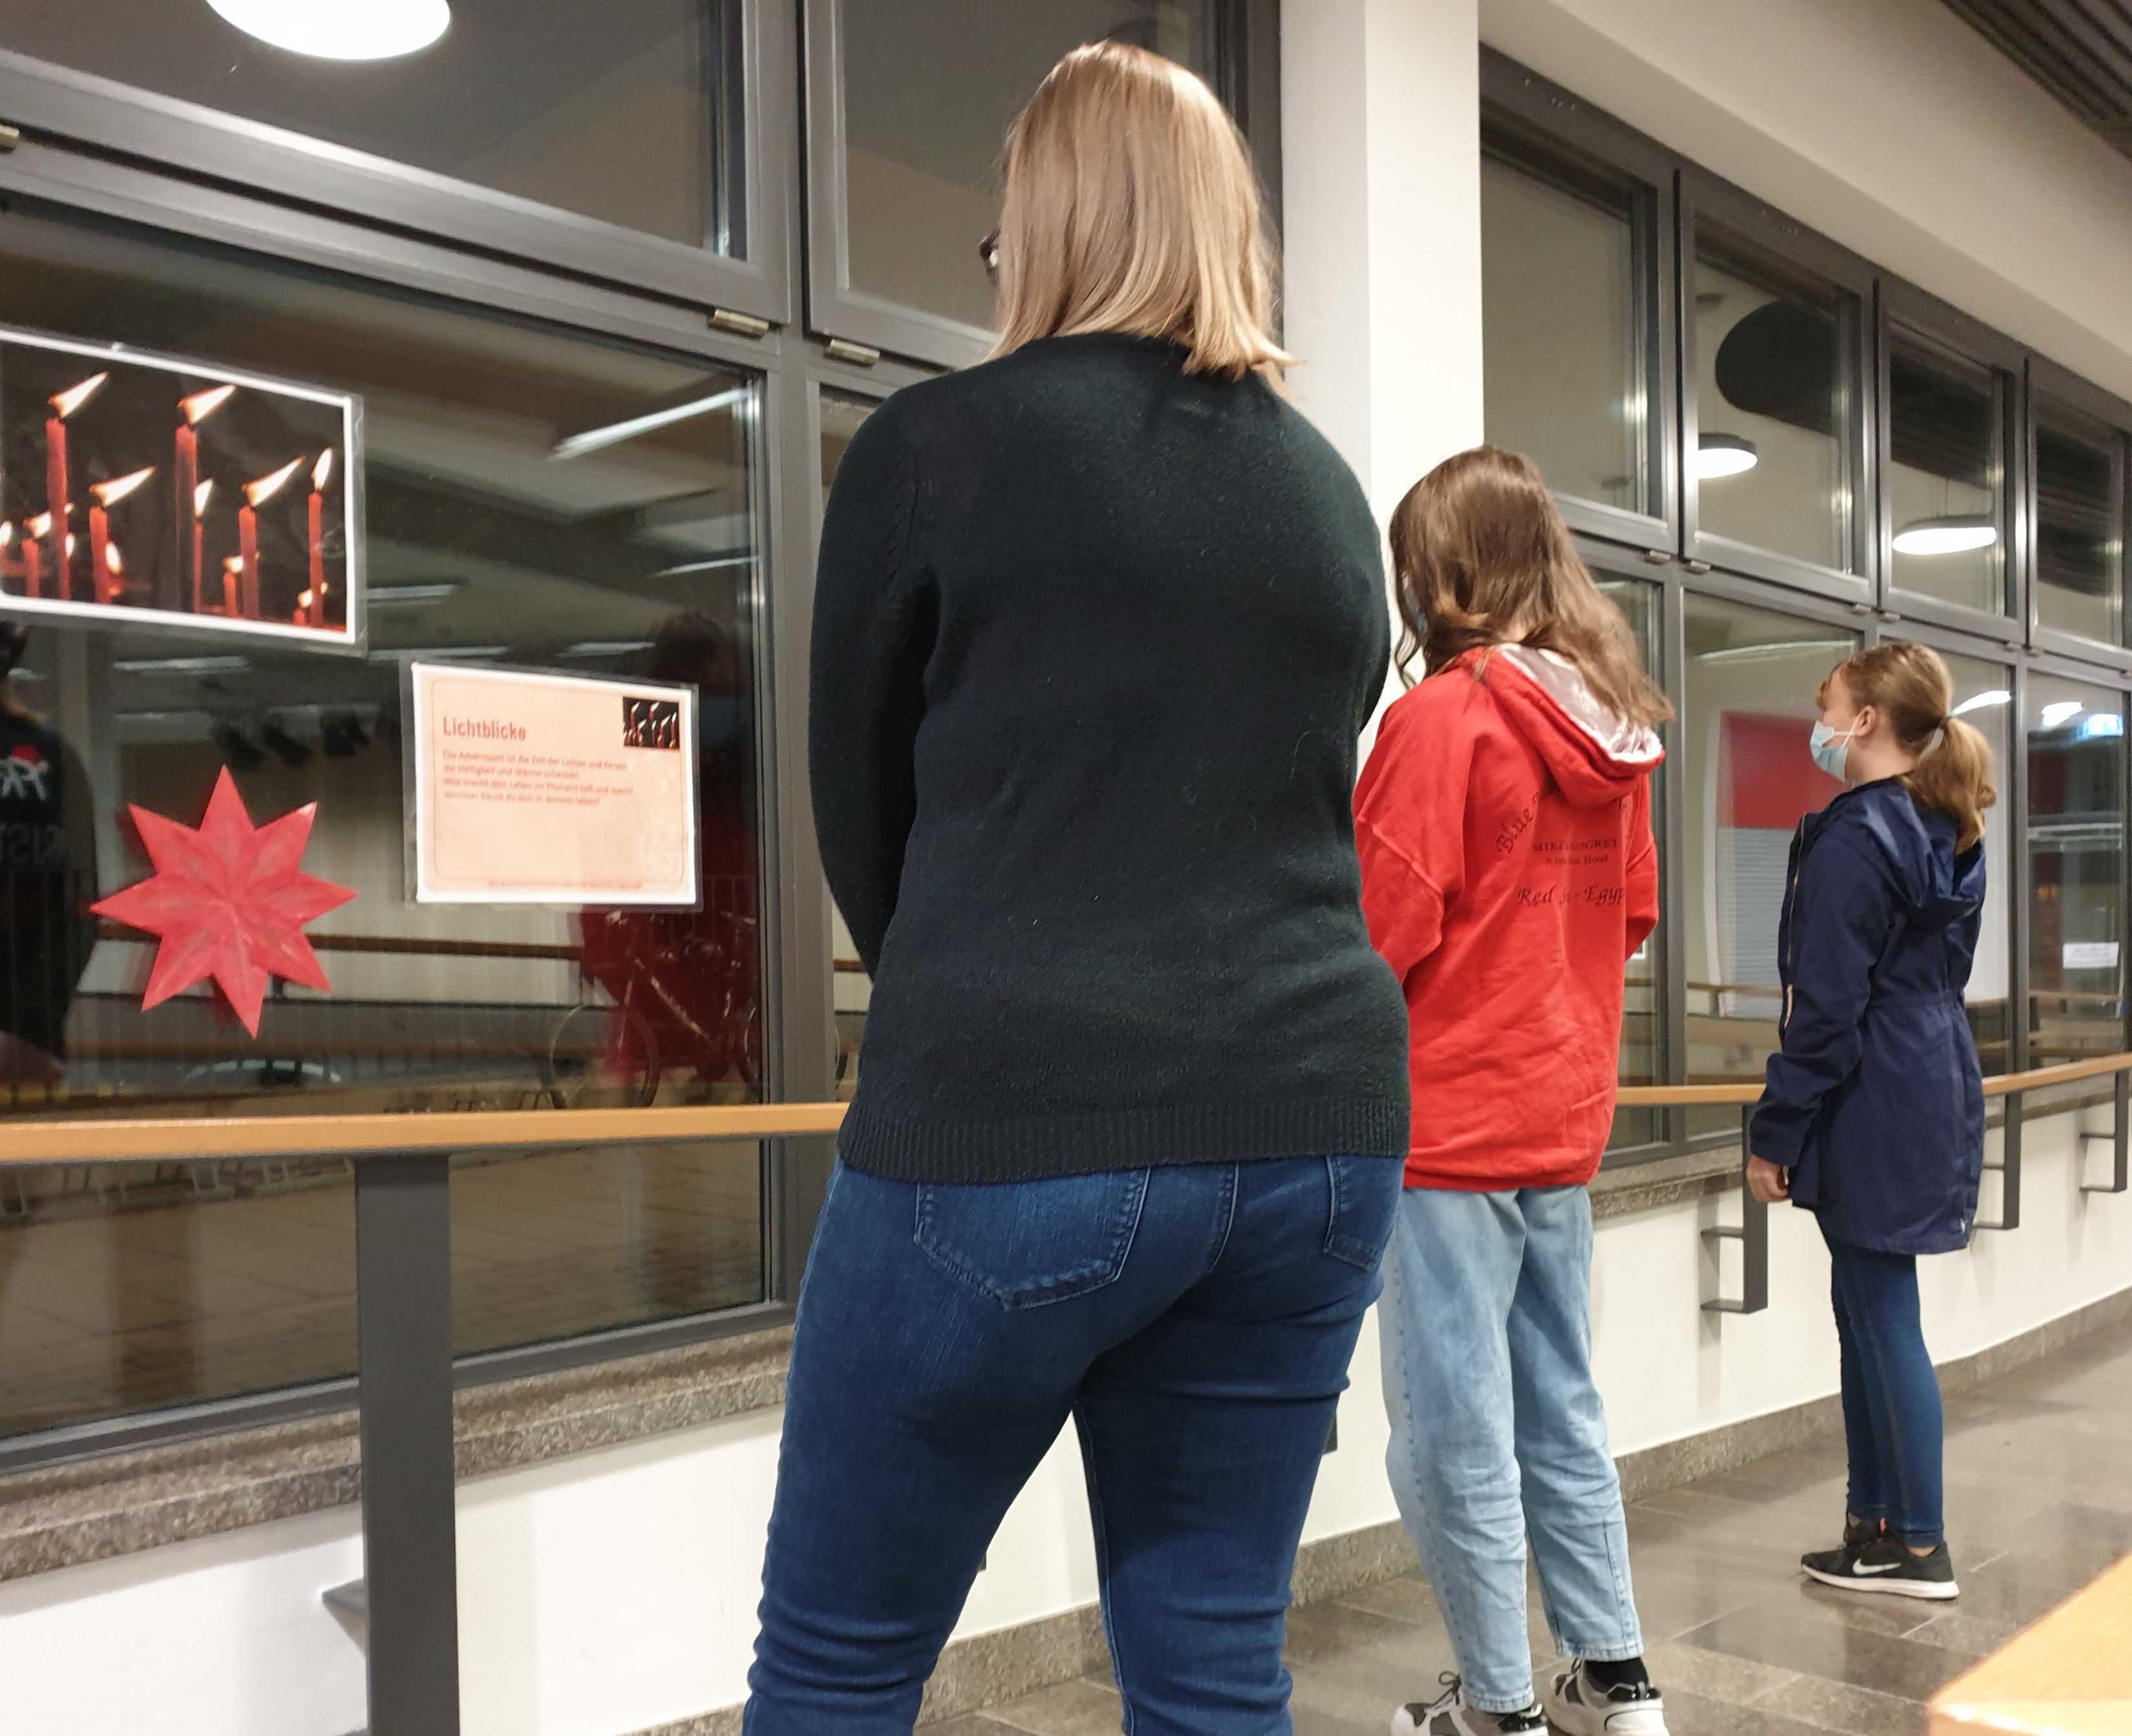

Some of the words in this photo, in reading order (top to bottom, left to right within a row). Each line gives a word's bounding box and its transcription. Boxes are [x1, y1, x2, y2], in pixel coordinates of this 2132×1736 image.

[443, 716, 526, 741] Lichtblicke
[497, 767, 513, 775] und
[588, 760, 602, 768] und
[1495, 807, 1534, 854] Blue
[1517, 884, 1557, 908] Red
